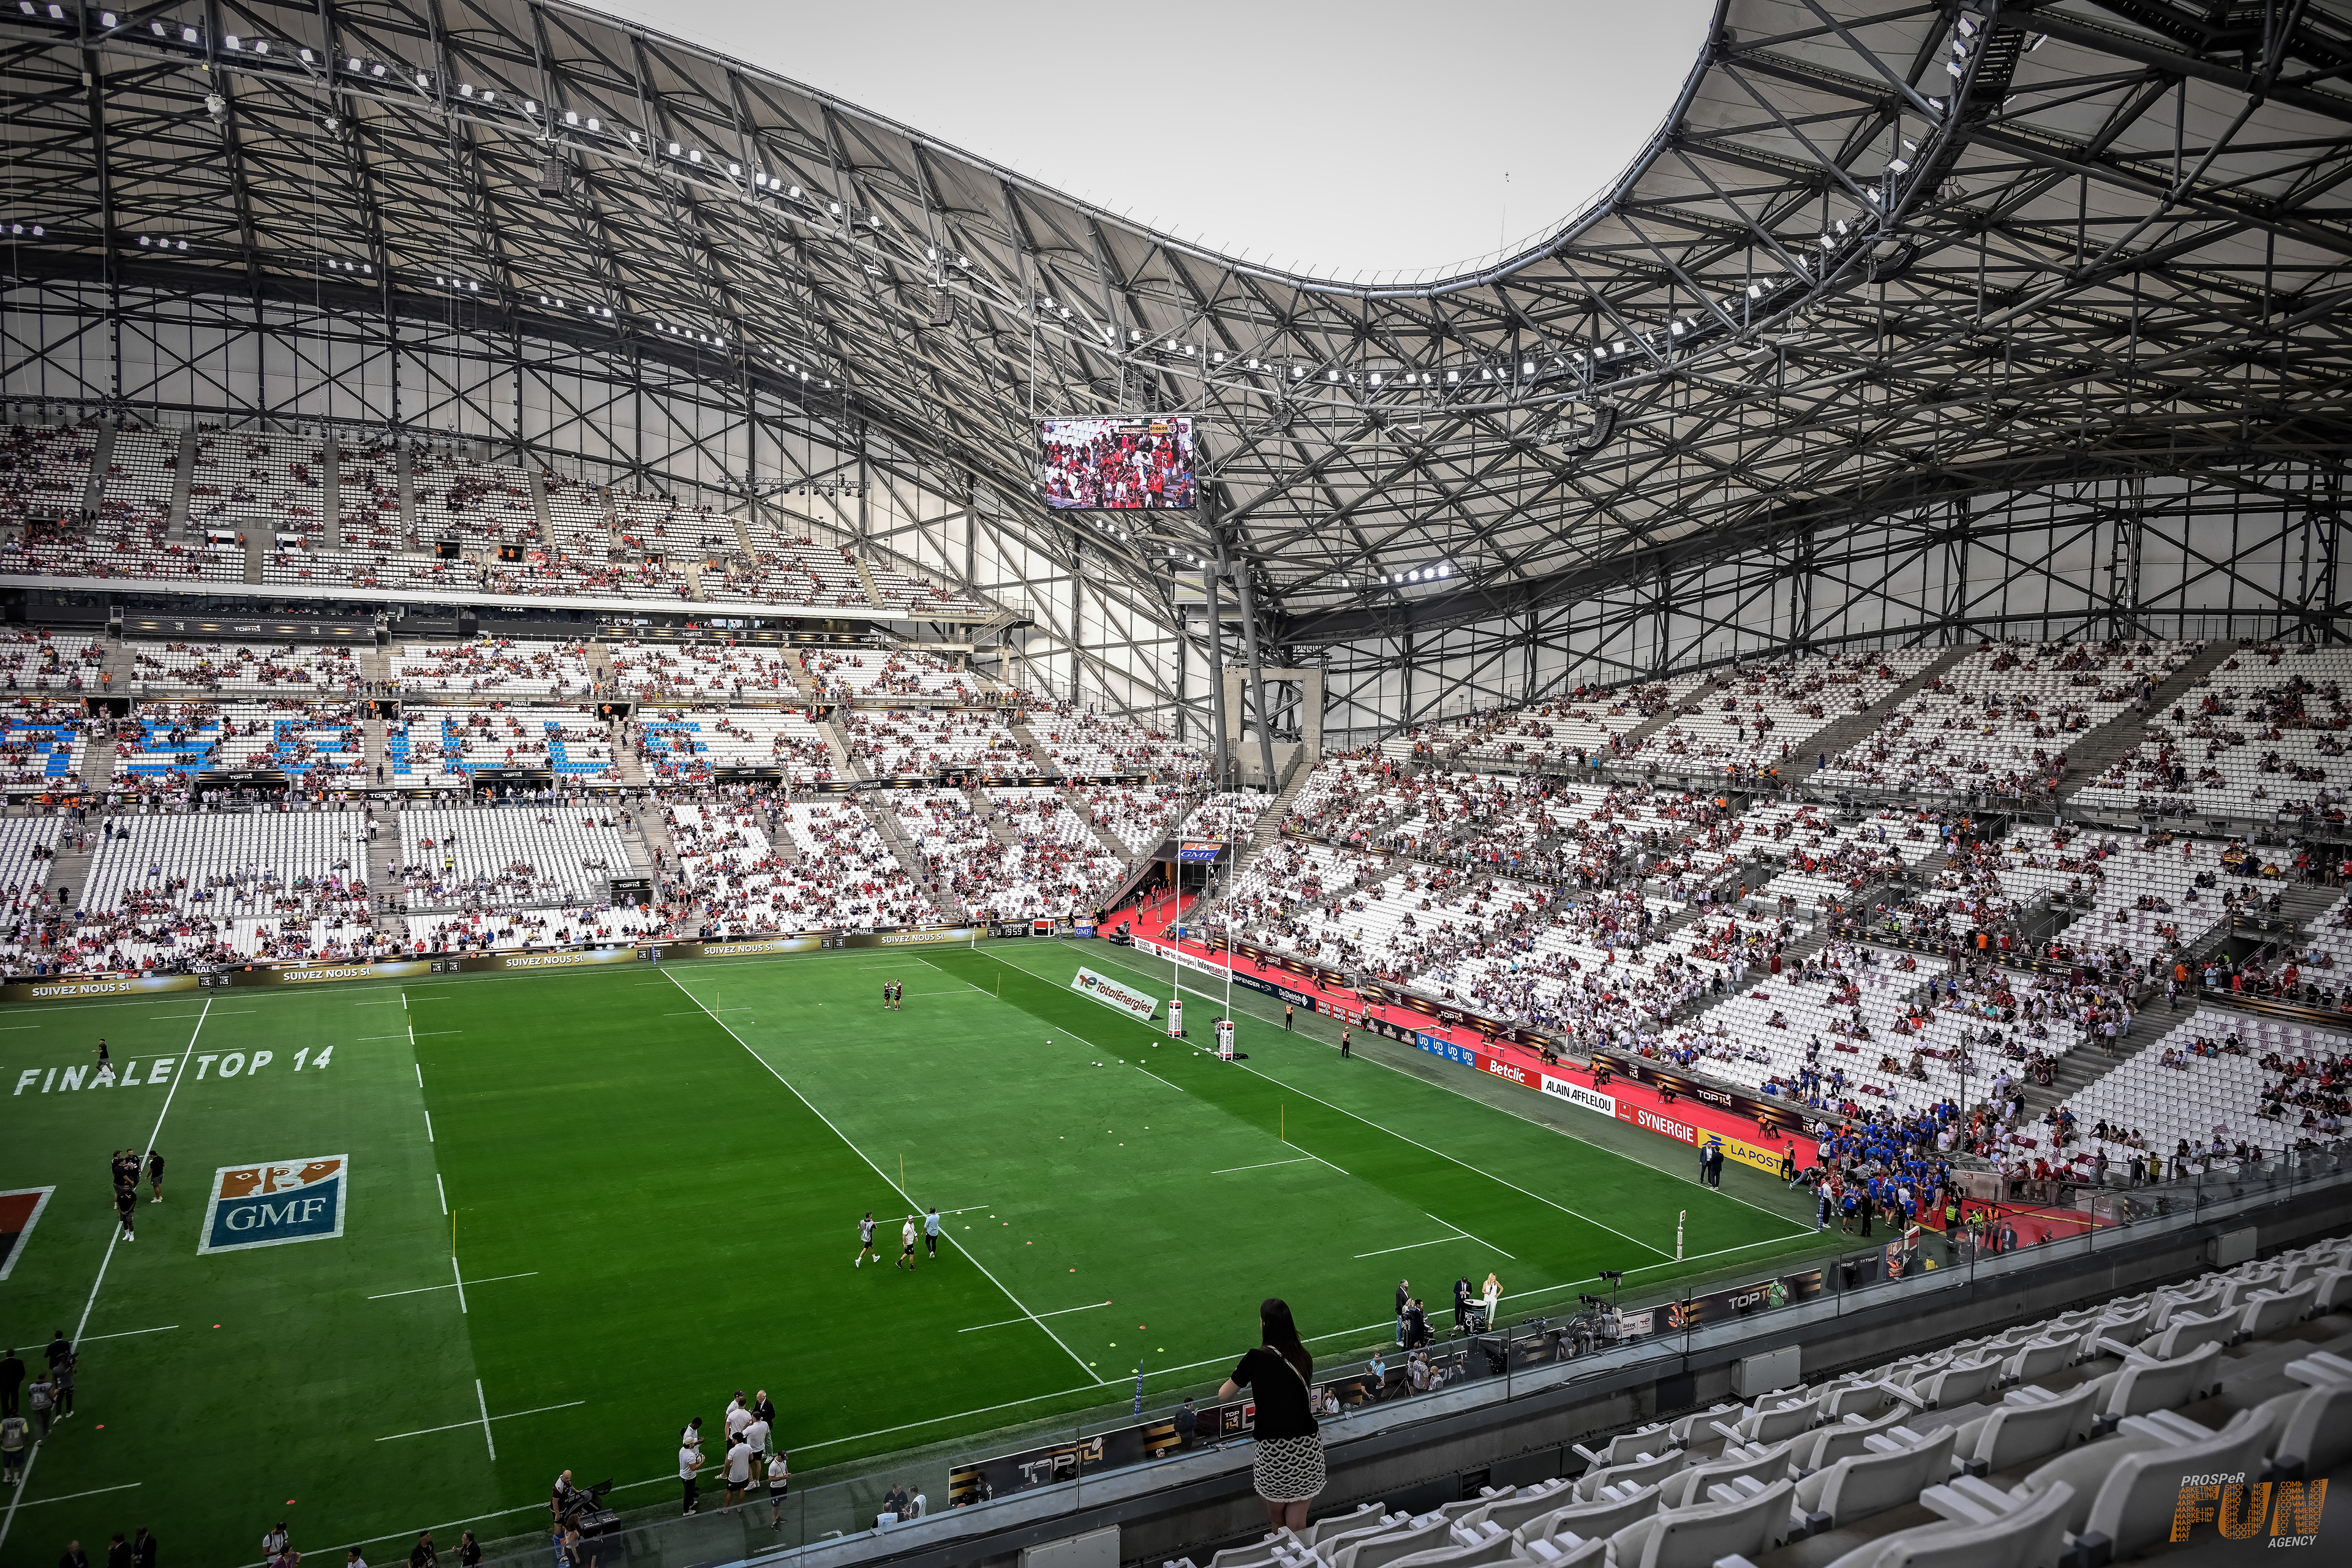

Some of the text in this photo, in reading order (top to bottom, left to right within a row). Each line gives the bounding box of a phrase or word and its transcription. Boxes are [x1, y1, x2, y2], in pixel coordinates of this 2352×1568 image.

[881, 935, 910, 944] SUIVEZ
[912, 934, 934, 943] NOUS
[704, 946, 736, 955] SUIVEZ
[738, 944, 763, 953] NOUS
[1138, 944, 1153, 954] GENERALE
[506, 958, 541, 967] SUIVEZ
[1170, 952, 1194, 966] TotlEnergies
[1265, 956, 1281, 966] TOP14
[283, 971, 323, 981] SUIVEZ
[326, 969, 357, 978] NOUS
[1233, 974, 1260, 989] DEFENDER
[32, 986, 77, 997] SUIVEZ
[80, 983, 116, 993] NOUS
[1096, 981, 1152, 1014] TotalEnergies
[1285, 990, 1301, 1002] Dietrich
[1318, 1000, 1330, 1009] BRICO
[1333, 1006, 1346, 1014] BRICO
[1349, 1011, 1362, 1020] BRICO
[1383, 1030, 1396, 1038] ANDROS
[1401, 1036, 1415, 1044] ANDROS
[13, 1046, 334, 1095] FINALE TOP 14
[1490, 1059, 1525, 1083] Betclic
[1629, 1069, 1638, 1079] 14
[1546, 1080, 1611, 1111] ALAIN AFFLELOU
[1697, 1089, 1732, 1107] TOP14
[1638, 1109, 1694, 1143] SYNERGIE
[1803, 1123, 1814, 1134] 14
[1731, 1144, 1789, 1175] LA POST
[226, 1197, 326, 1231] GMF
[32, 1393, 45, 1403] TV
[1225, 1420, 1238, 1429] 14
[8, 1428, 20, 1439] TV
